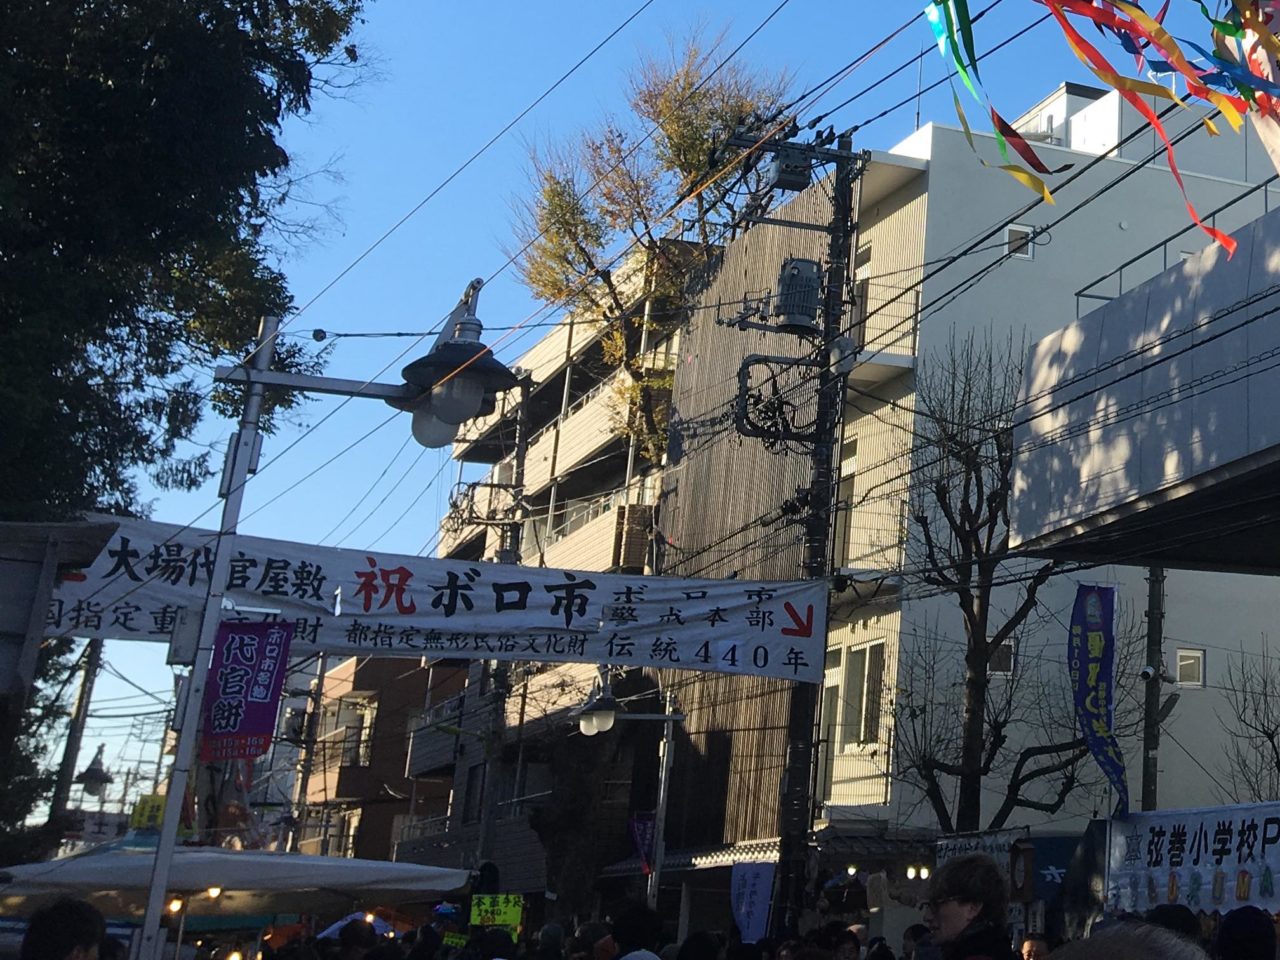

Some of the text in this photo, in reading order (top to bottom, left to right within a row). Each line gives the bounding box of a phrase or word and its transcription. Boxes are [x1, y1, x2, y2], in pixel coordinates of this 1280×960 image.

[102, 536, 327, 601] 大場代官屋敷
[354, 556, 417, 615] 祝
[428, 567, 597, 629] ボロ市
[613, 584, 777, 605] ボロ市
[345, 619, 586, 655] 都指定無形民俗文化財
[608, 606, 775, 632] 警戒本部
[605, 633, 810, 675] 伝統440年
